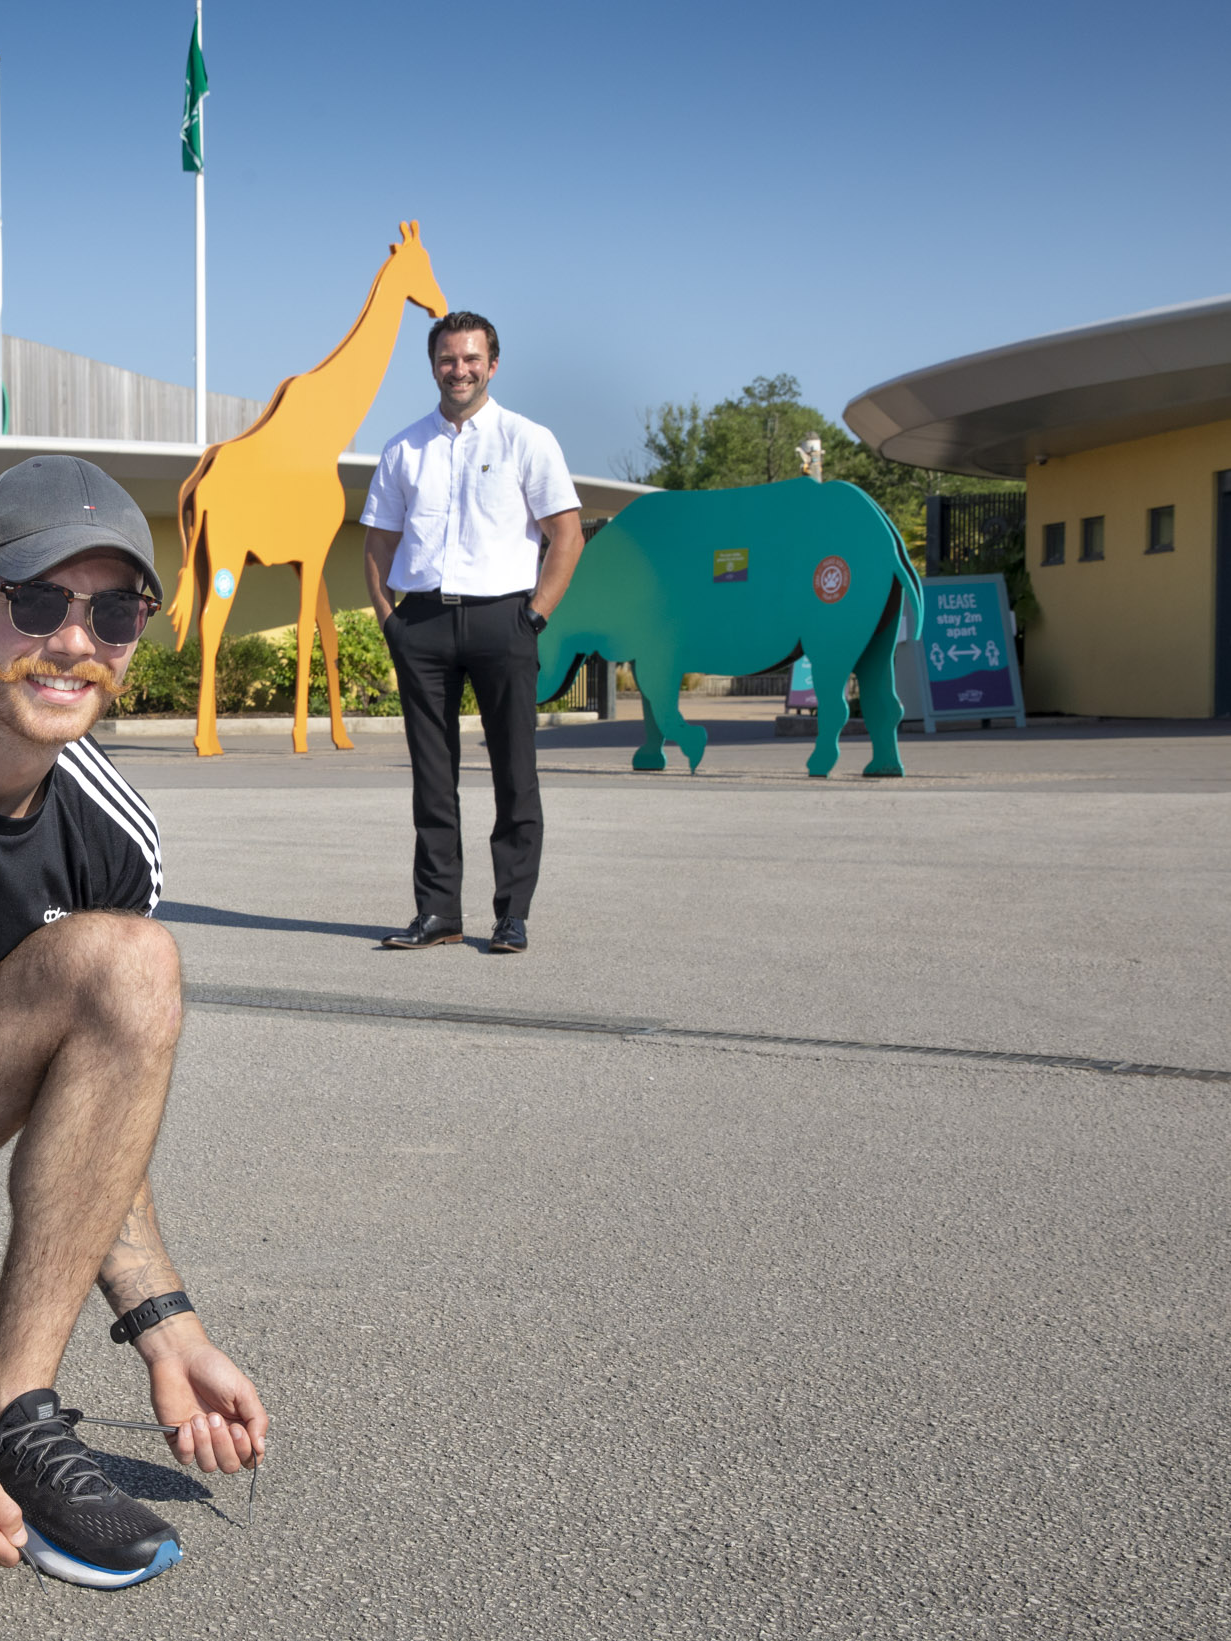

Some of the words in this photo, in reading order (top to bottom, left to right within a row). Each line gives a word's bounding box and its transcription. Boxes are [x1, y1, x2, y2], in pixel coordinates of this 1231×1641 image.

[937, 593, 977, 610] PLEASE
[936, 612, 962, 626] stay
[963, 612, 982, 623] 2m
[946, 625, 977, 639] apart
